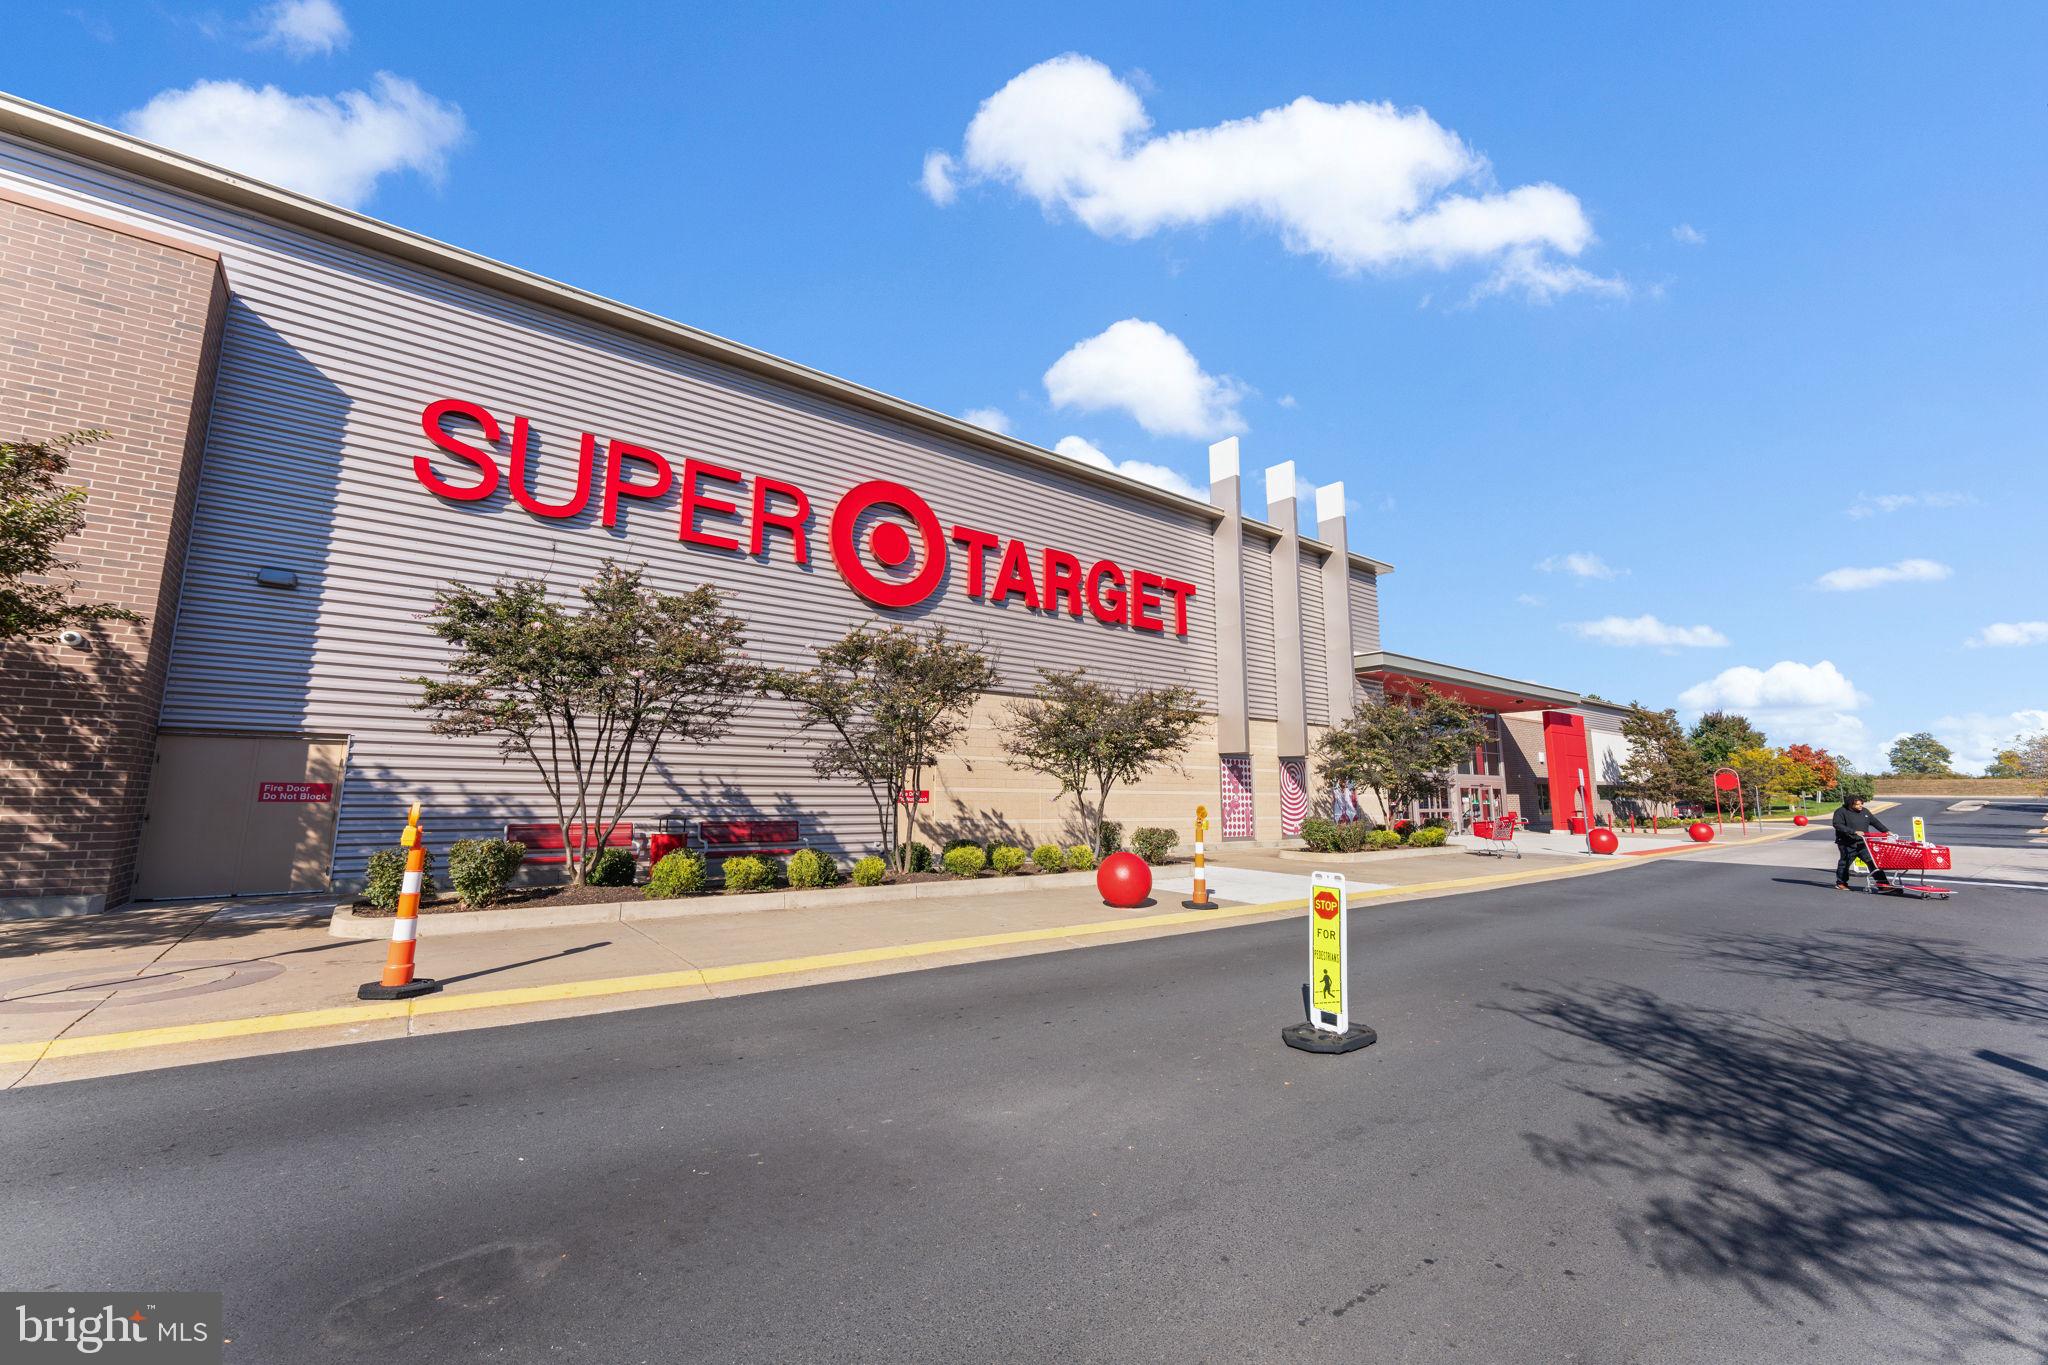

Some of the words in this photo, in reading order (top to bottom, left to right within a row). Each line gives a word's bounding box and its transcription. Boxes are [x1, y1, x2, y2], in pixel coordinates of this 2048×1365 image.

[413, 399, 811, 565] SUPER
[952, 524, 1196, 637] TARGET
[264, 784, 283, 792] Fire
[286, 784, 311, 792] Door
[263, 792, 276, 800] Do
[279, 792, 297, 800] Not
[299, 792, 327, 800] Block
[1315, 900, 1337, 911] STOP
[1317, 928, 1336, 940] FOR
[1314, 949, 1340, 963] PEDESTRIANS
